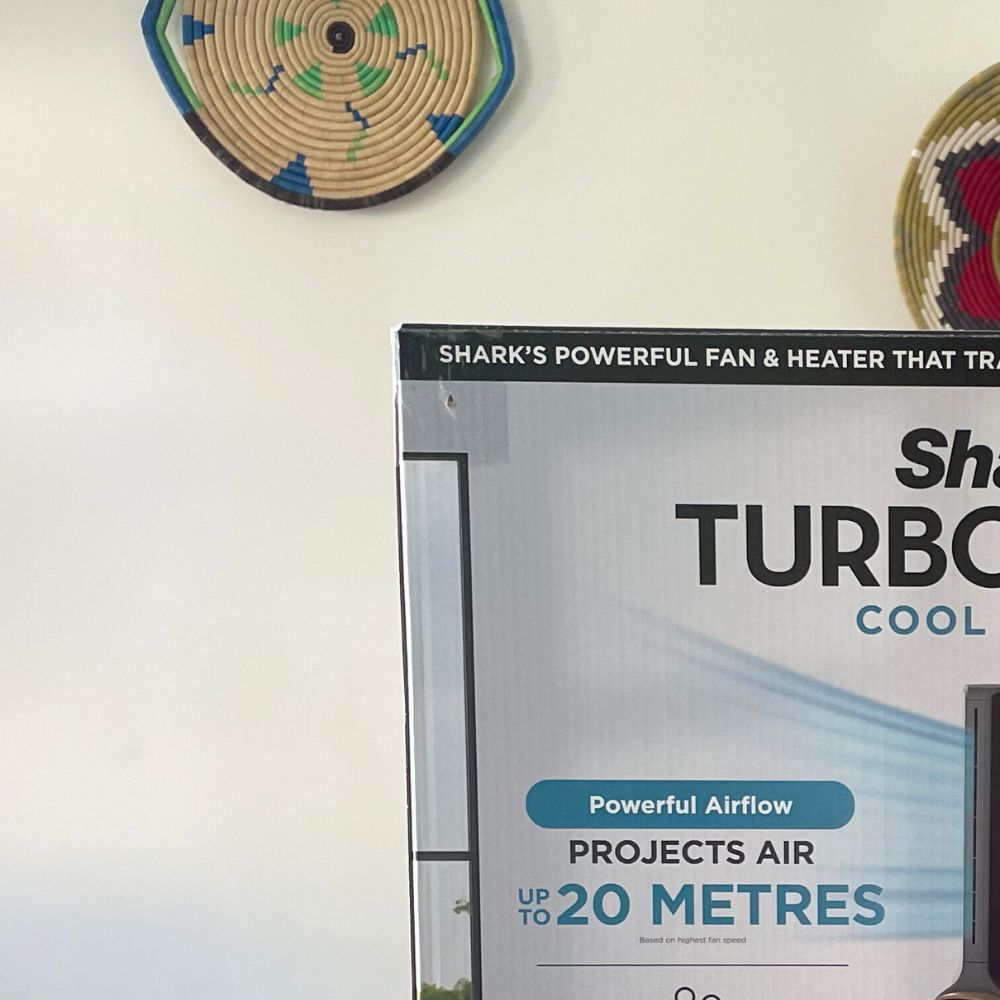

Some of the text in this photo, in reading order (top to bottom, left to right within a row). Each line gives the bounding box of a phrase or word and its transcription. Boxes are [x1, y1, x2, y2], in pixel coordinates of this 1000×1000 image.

[439, 344, 547, 365] SHARK'S
[555, 346, 698, 367] POWERFUL
[706, 348, 755, 368] FAN
[763, 348, 779, 368] &
[787, 348, 884, 369] HEATER
[893, 350, 955, 370] THAT
[856, 605, 986, 635] COOL
[589, 795, 793, 815] Powerful Airflow
[569, 840, 814, 865] PROJECTS AIR
[518, 888, 550, 905] UP
[556, 883, 885, 926] 20 METRES
[518, 909, 551, 926] TO
[677, 937, 706, 946] highest
[722, 937, 747, 946] speed
